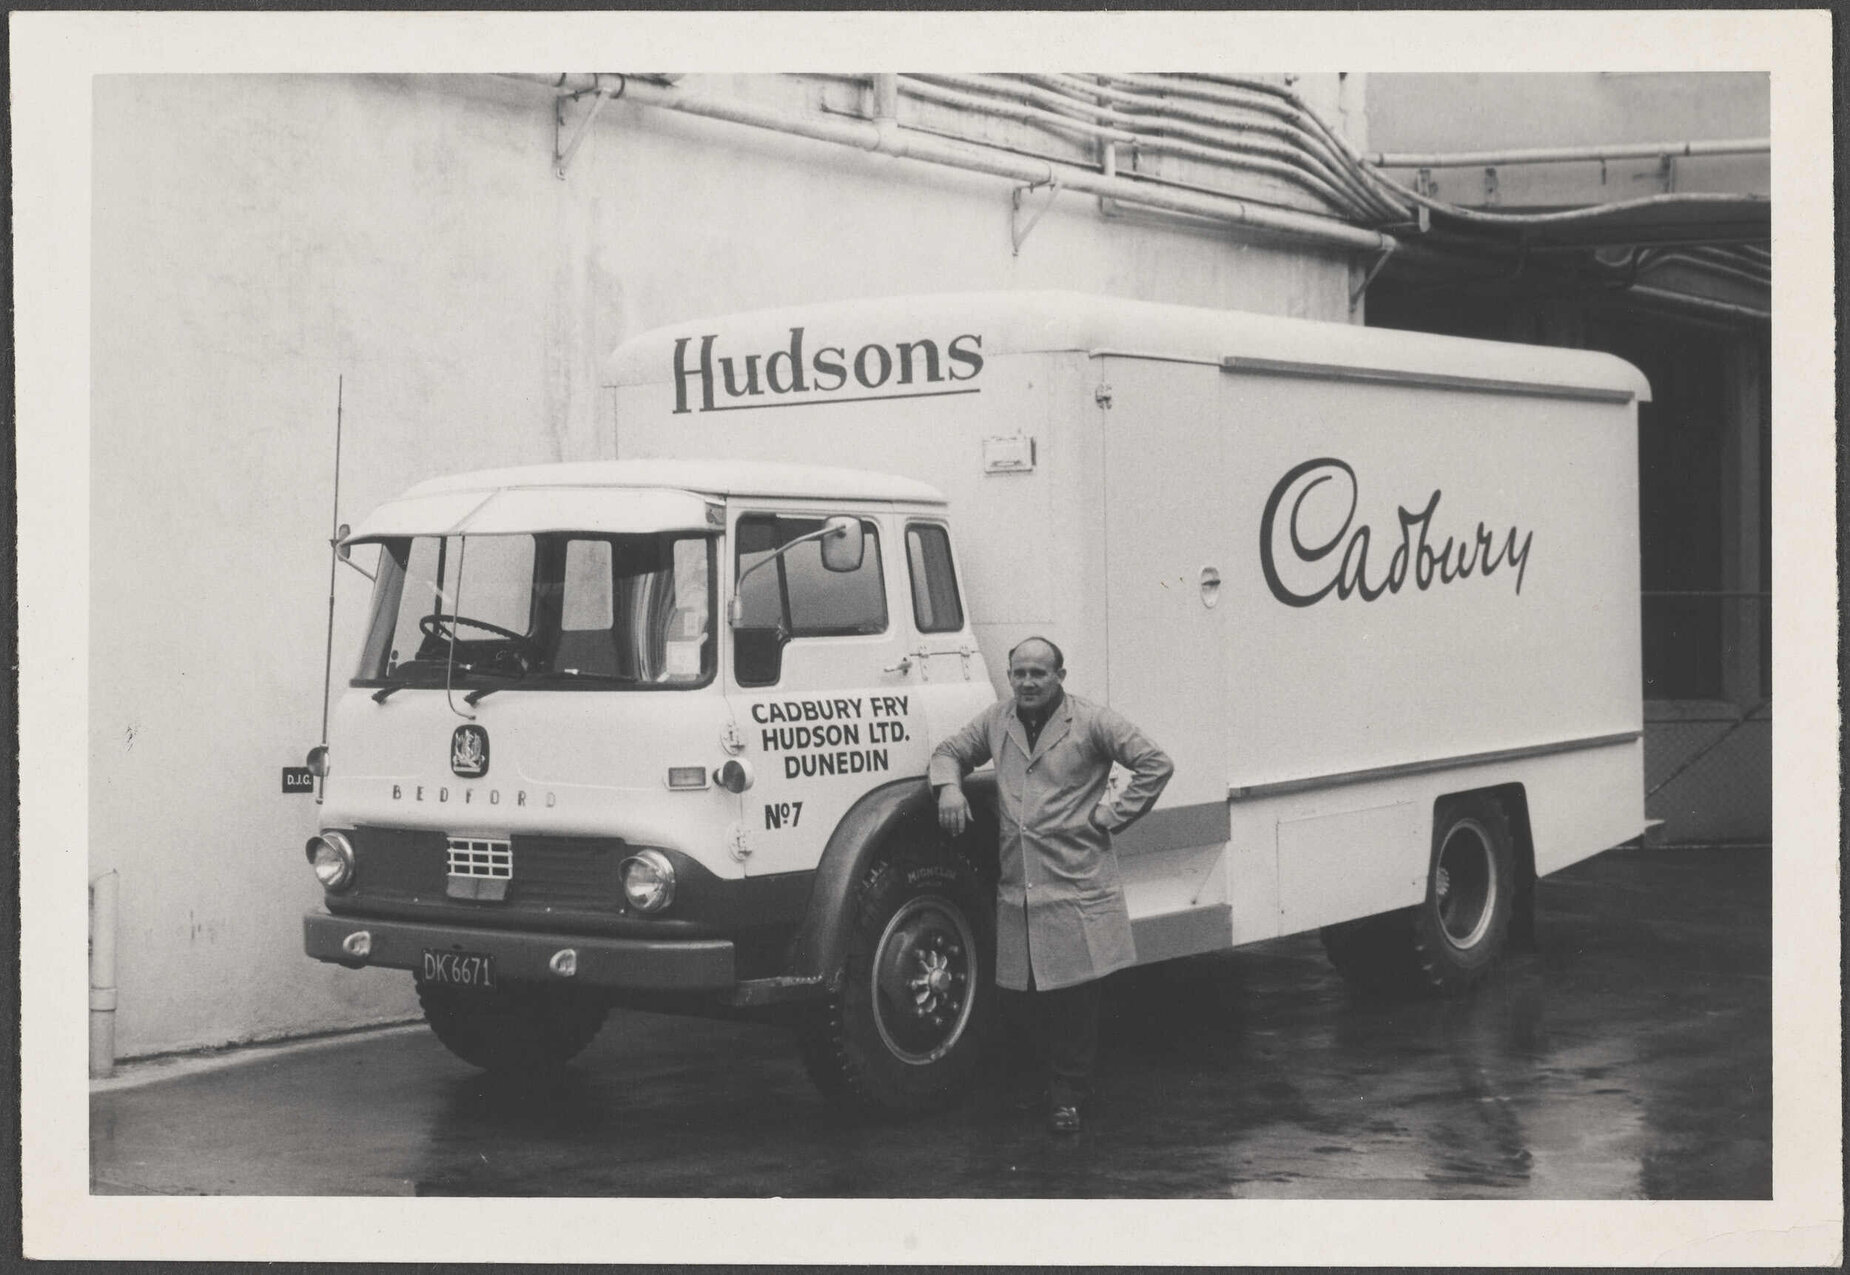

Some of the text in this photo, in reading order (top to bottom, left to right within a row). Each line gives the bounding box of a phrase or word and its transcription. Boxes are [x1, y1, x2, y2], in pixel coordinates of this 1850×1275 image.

[672, 327, 984, 414] Hudsons
[1259, 457, 1534, 608] Cadbury
[752, 696, 908, 724] CADBURY FRY
[762, 721, 910, 751] HUDSON LTD.
[785, 749, 889, 779] DUNEDIN
[392, 785, 556, 808] BEDFORD
